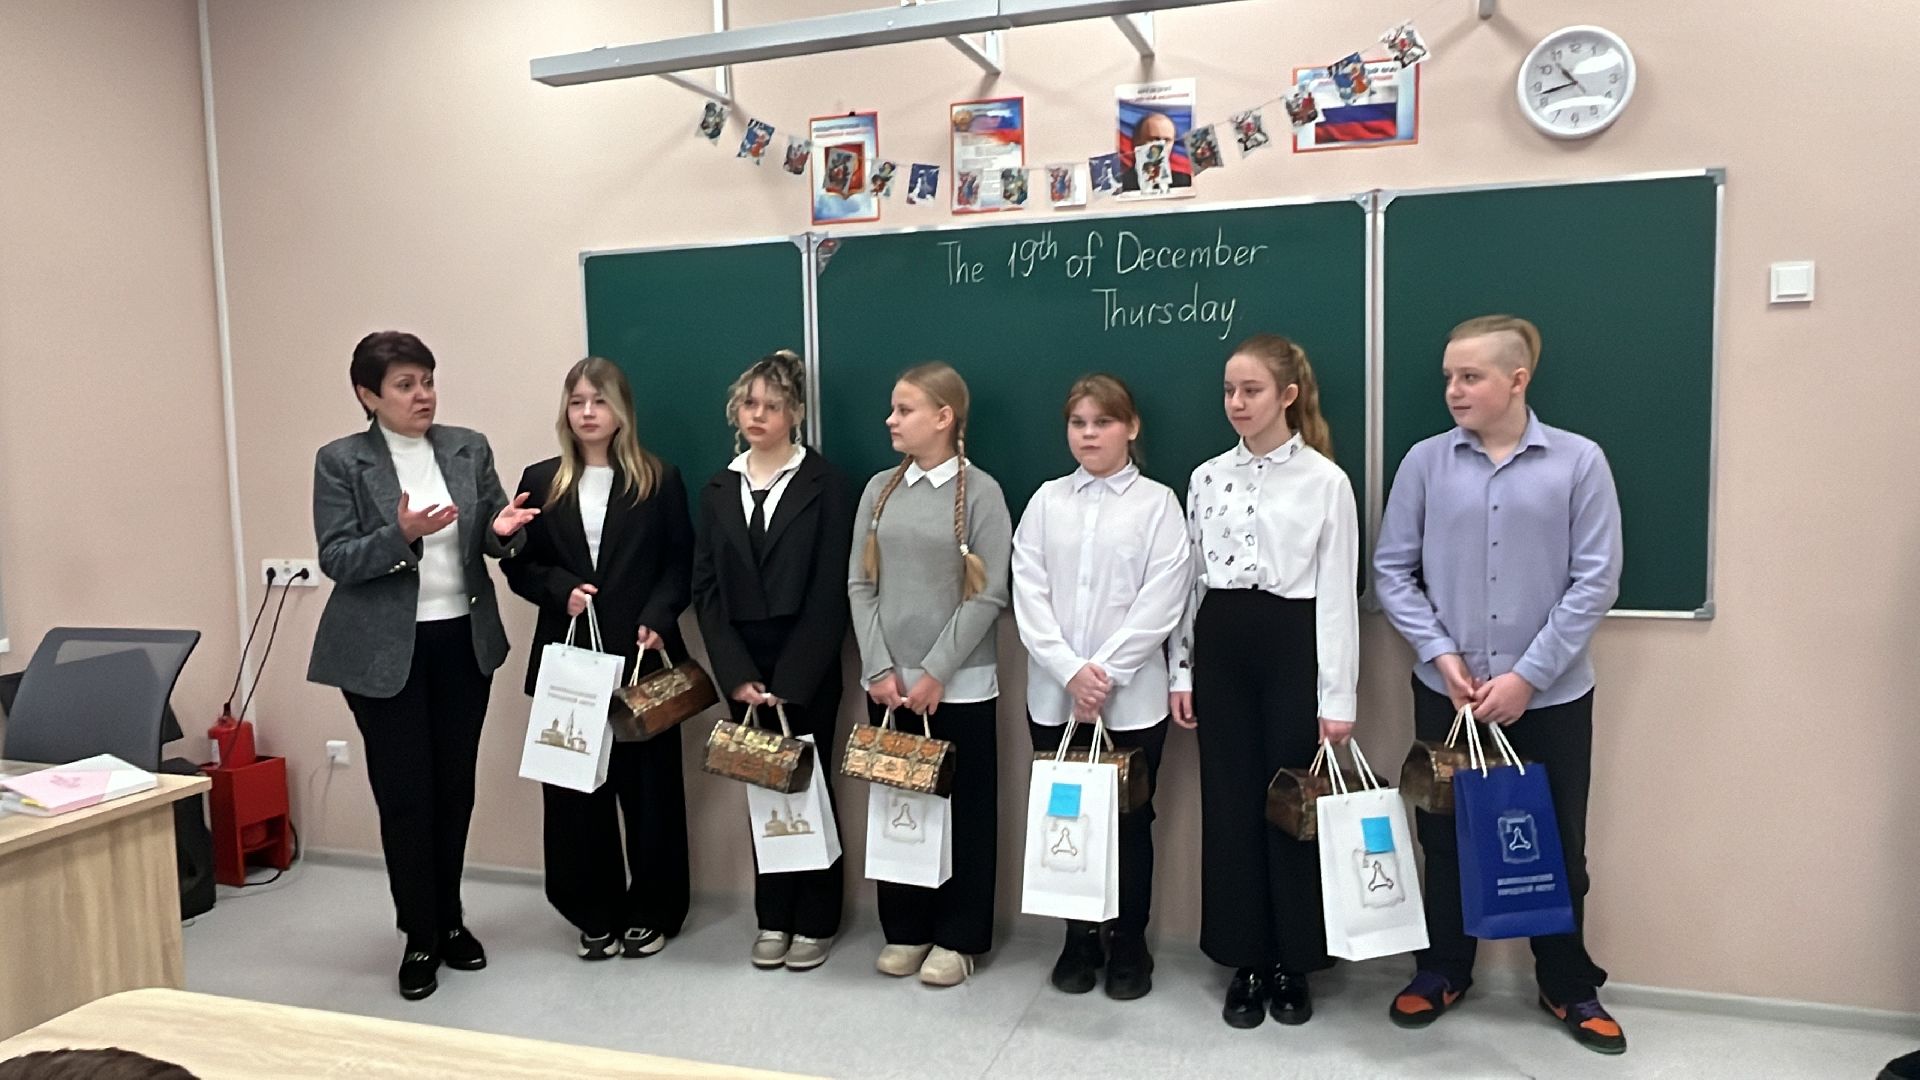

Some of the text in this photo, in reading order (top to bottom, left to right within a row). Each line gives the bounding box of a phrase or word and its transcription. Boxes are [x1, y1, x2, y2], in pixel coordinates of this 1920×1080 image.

[936, 226, 1268, 288] The 19th of December
[1091, 281, 1237, 341] Thursday
